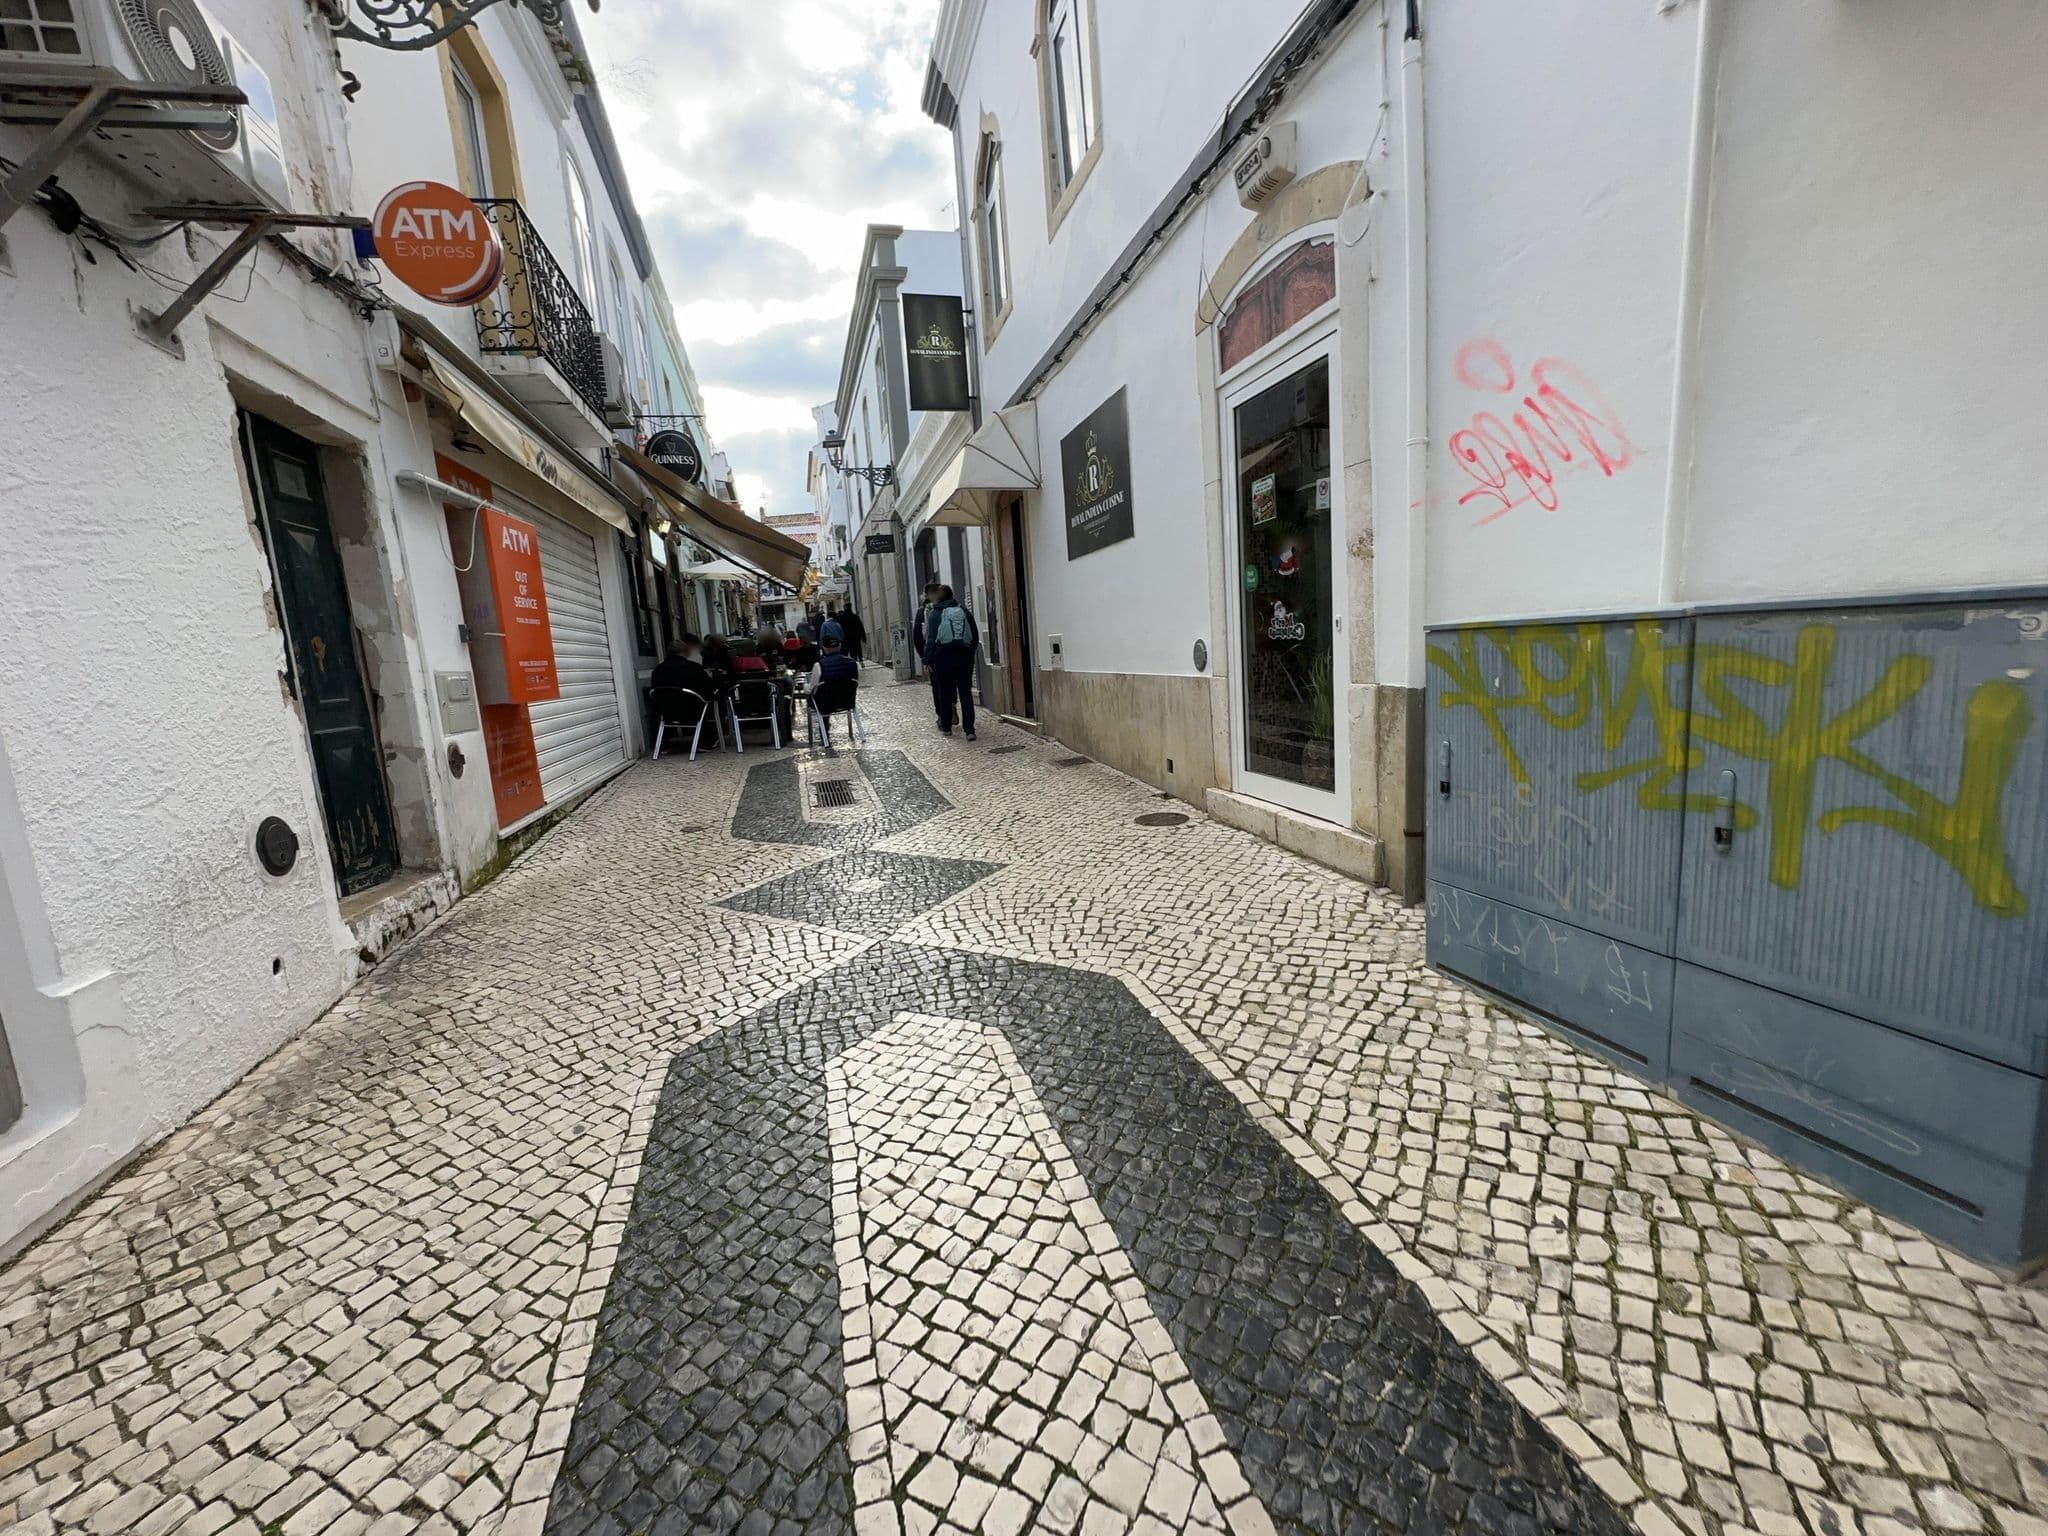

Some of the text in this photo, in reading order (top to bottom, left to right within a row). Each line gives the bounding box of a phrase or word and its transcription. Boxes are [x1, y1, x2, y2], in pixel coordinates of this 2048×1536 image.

[391, 207, 476, 241] ATM
[394, 240, 476, 260] Express
[651, 453, 695, 465] GUINNESS
[1088, 465, 1099, 492] R
[502, 526, 531, 556] ATM
[514, 570, 528, 584] OUT
[519, 584, 528, 596] OF
[514, 596, 538, 610] SERVICE
